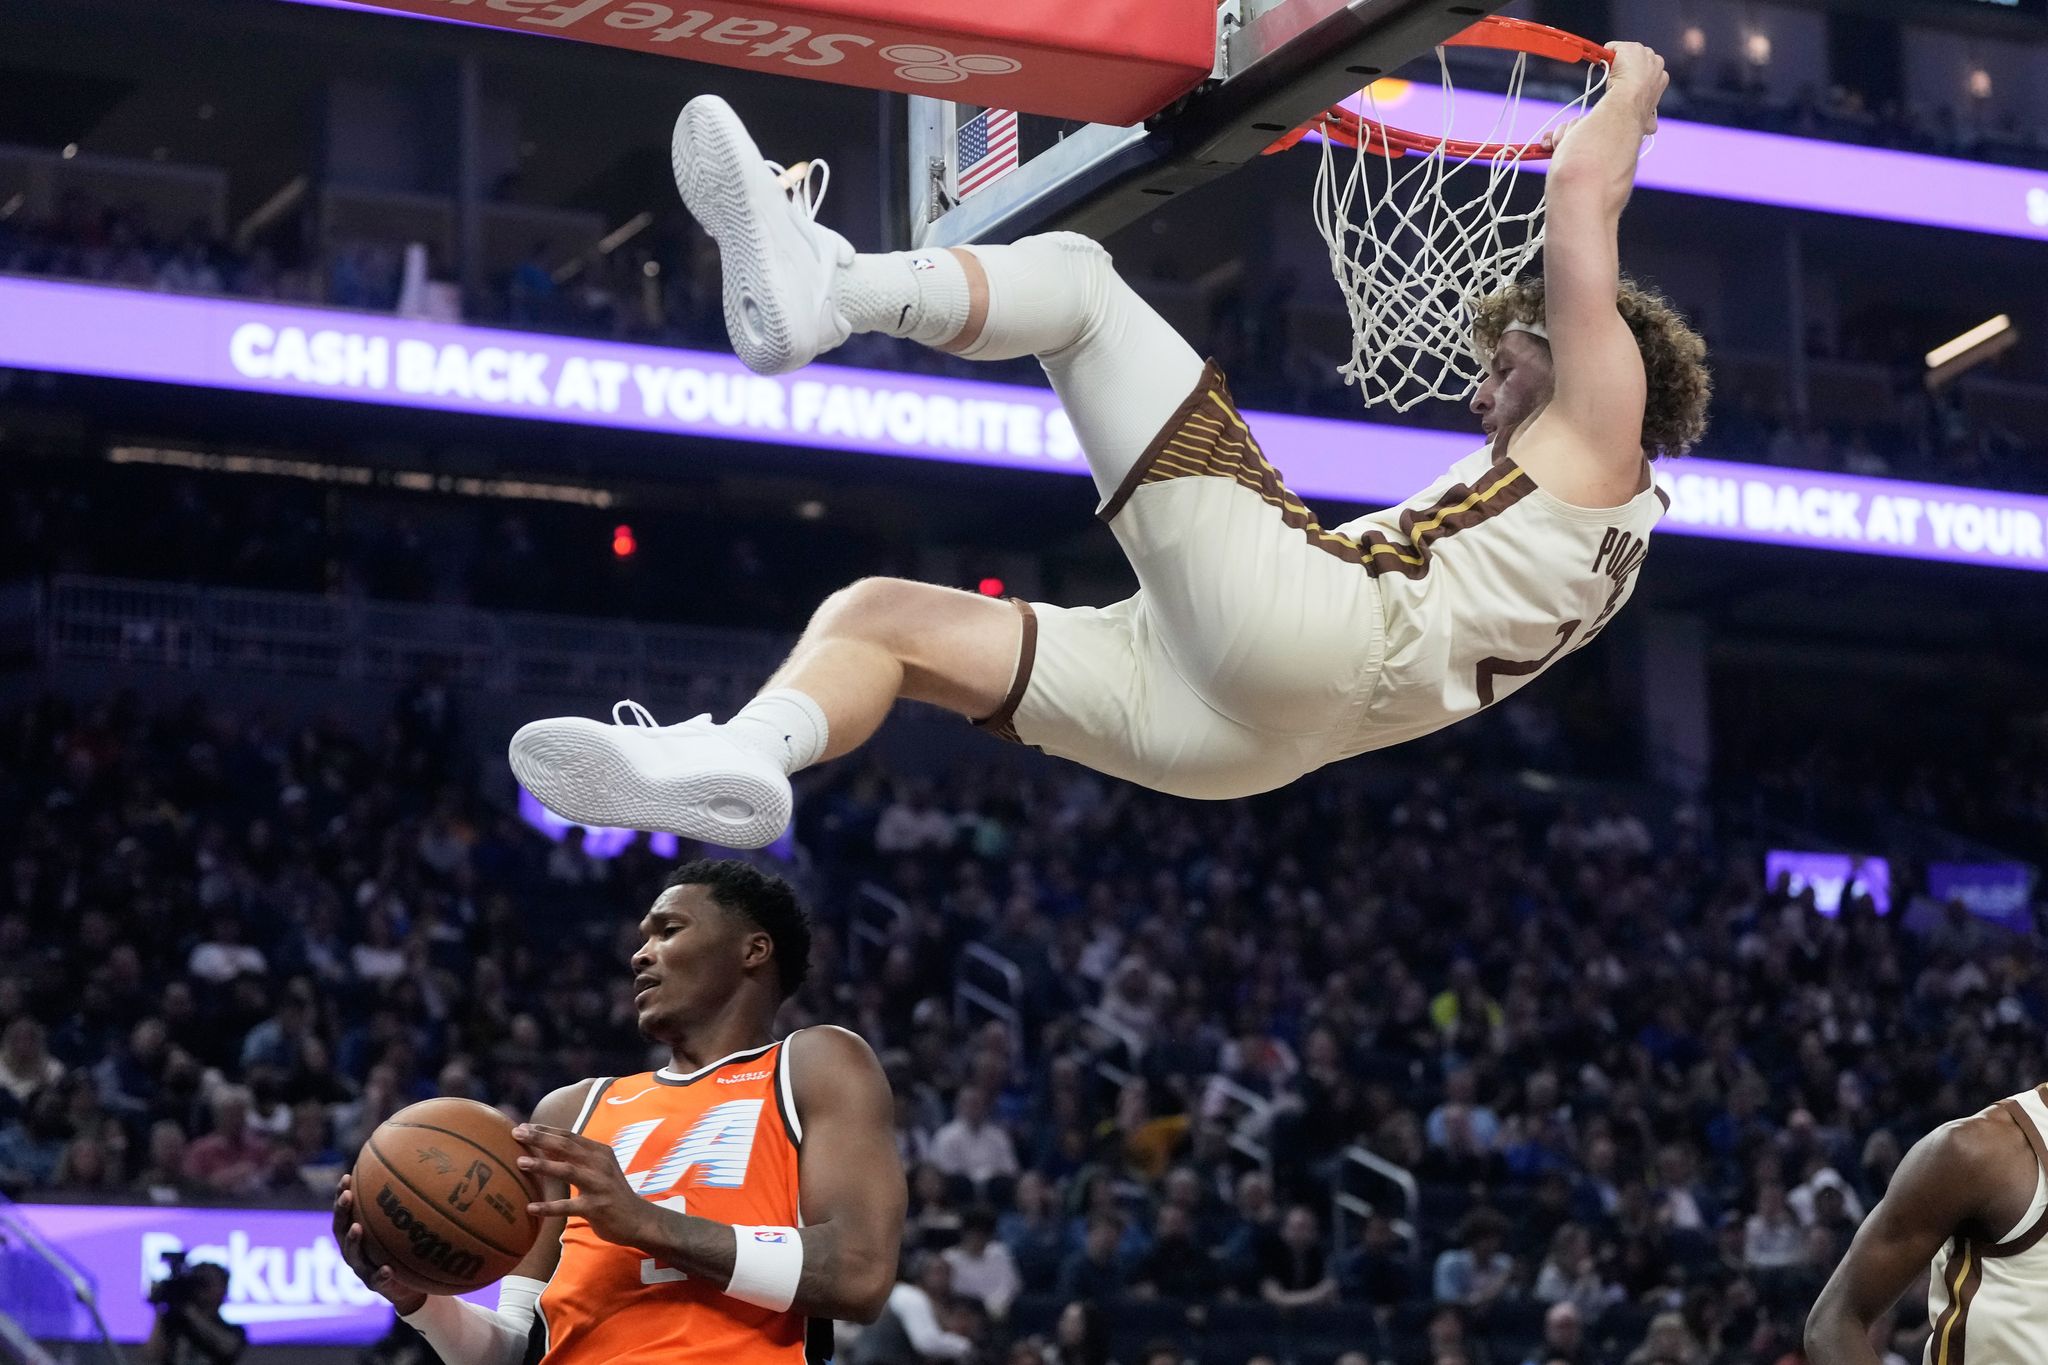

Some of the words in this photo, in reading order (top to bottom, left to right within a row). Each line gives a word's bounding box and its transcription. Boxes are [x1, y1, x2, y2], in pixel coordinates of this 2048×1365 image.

[229, 322, 390, 389] CASH
[396, 340, 550, 405] BACK
[554, 357, 628, 417] AT
[632, 363, 789, 430] YOUR
[791, 380, 1043, 457] FAVORITE
[1743, 480, 1863, 540] BACK
[1865, 495, 1923, 546] AT
[1925, 501, 2045, 559] YOUR
[732, 1070, 766, 1080] VISIT
[141, 1229, 395, 1308] Rkute
